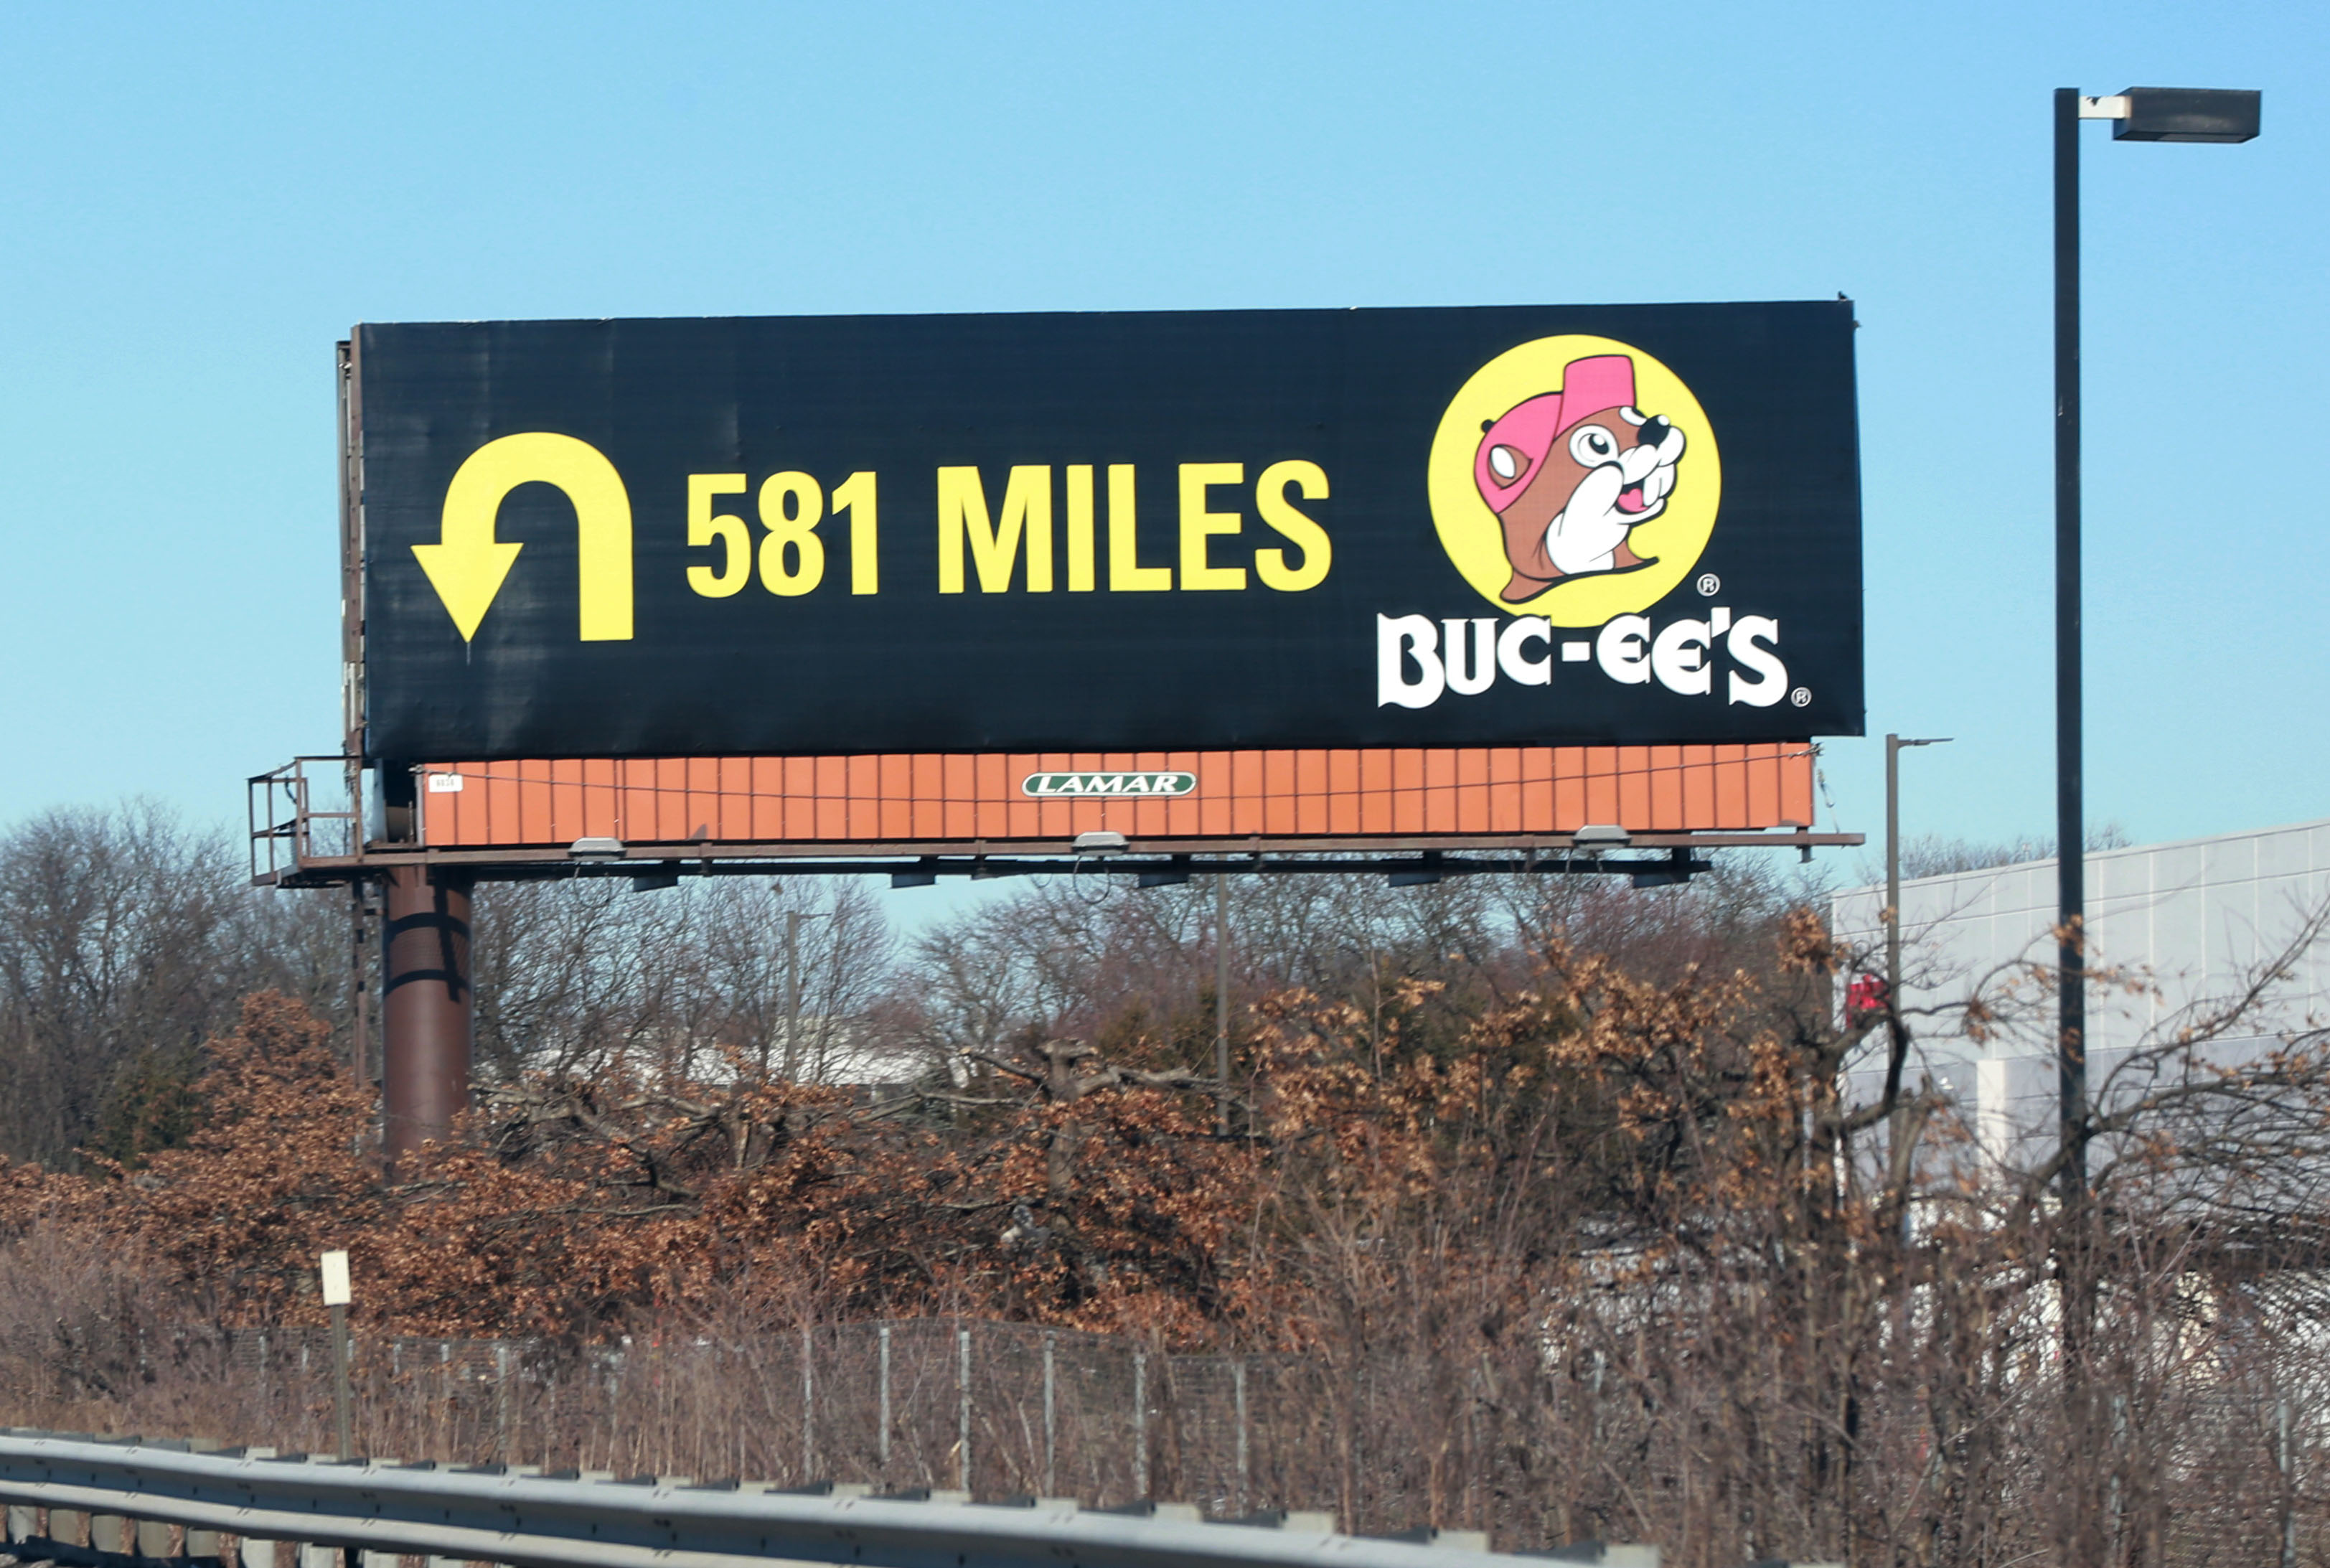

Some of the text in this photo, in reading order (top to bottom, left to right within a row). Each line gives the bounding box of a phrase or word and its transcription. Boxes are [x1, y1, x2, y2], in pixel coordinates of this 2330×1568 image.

[687, 460, 1331, 598] 581 MILES
[1377, 607, 1788, 709] BUC-EE'S
[1037, 776, 1178, 792] LAMAR
